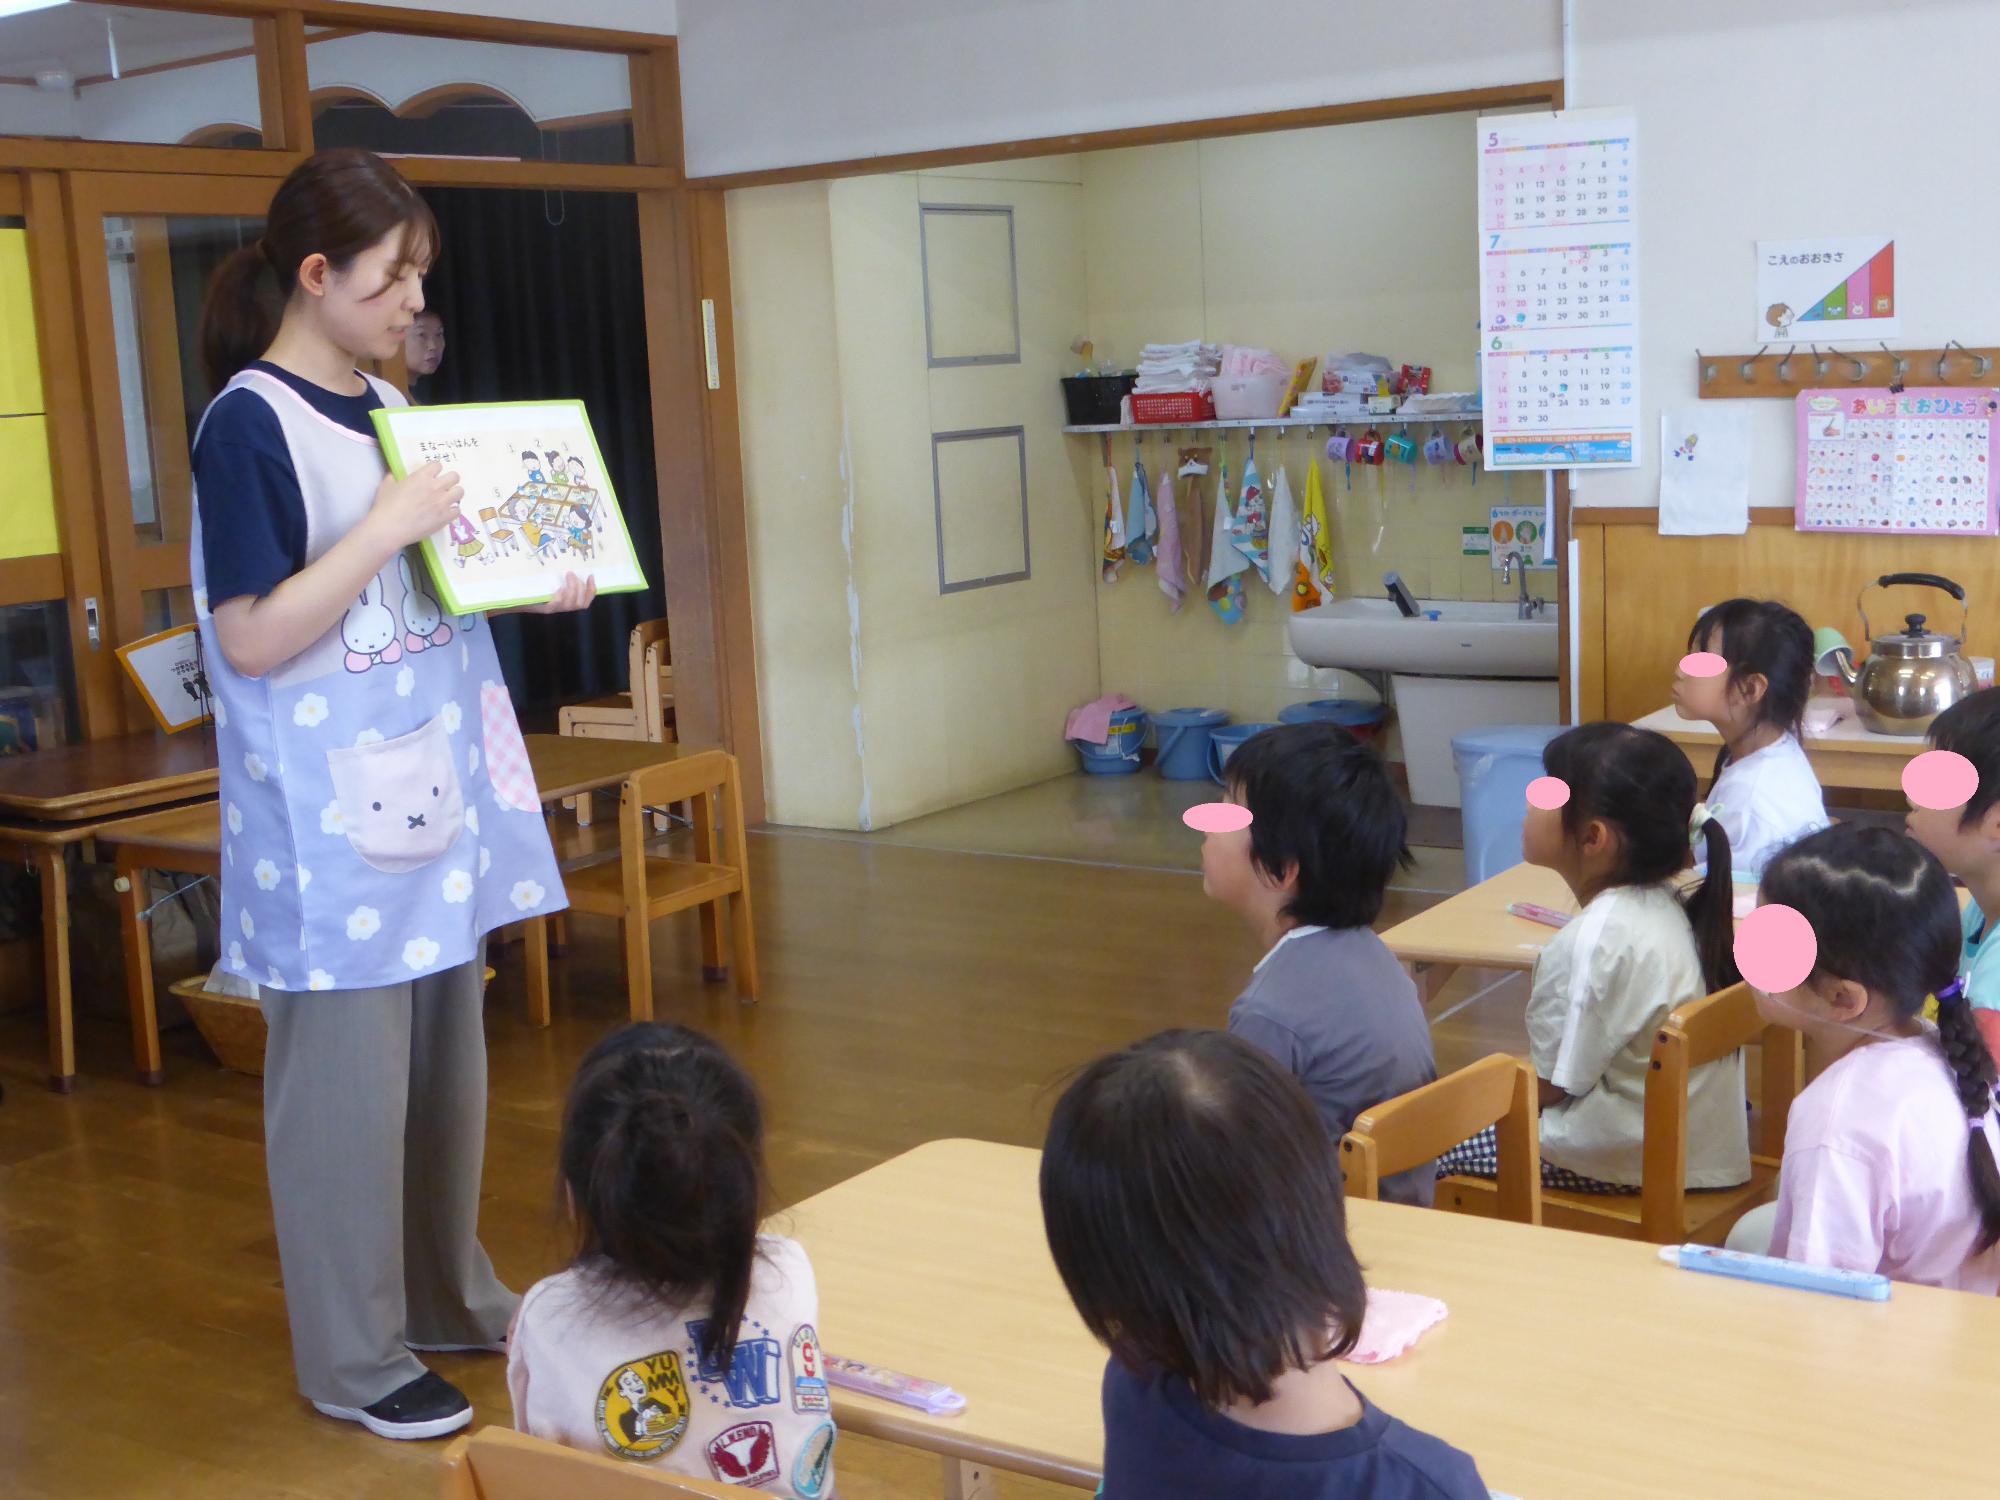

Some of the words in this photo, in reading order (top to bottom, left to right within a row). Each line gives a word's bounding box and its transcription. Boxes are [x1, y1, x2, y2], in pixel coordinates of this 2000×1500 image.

[1489, 132, 1498, 147] 5
[1490, 235, 1500, 249] 7
[1768, 252, 1844, 266] こえのおおきさ
[1491, 337, 1502, 350] 6
[1853, 398, 1977, 415] あいうえおひょう
[644, 1355, 674, 1374] YU
[647, 1370, 681, 1393] MM
[666, 1385, 680, 1402] Y
